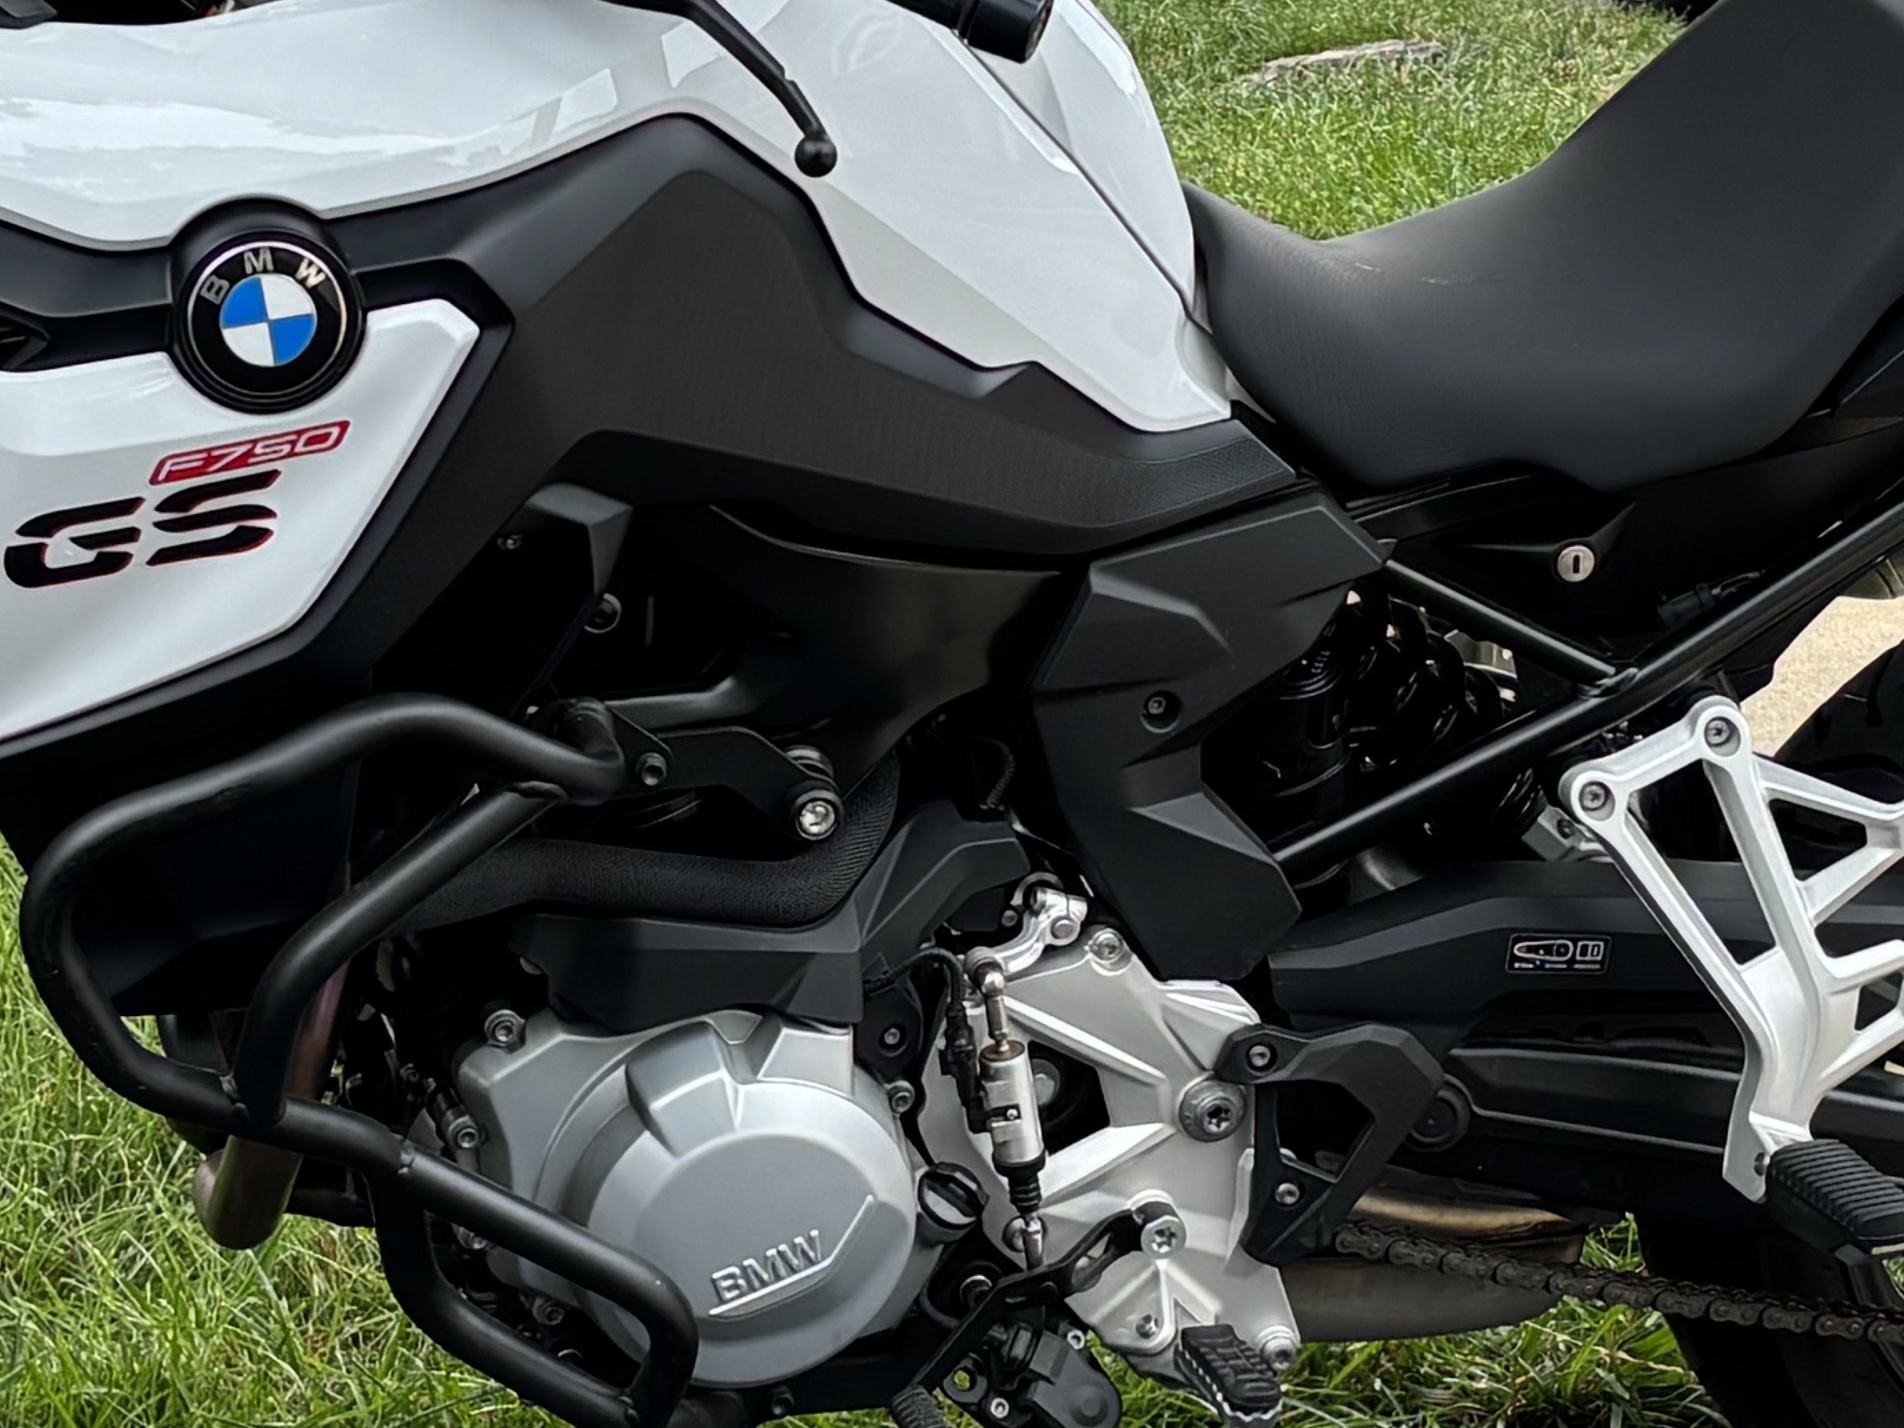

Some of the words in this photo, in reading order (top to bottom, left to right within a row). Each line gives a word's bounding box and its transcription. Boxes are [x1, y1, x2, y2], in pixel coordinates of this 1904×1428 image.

[201, 247, 326, 306] BMW
[157, 425, 341, 482] F750
[3, 468, 282, 588] GS
[711, 1229, 822, 1301] BMW
